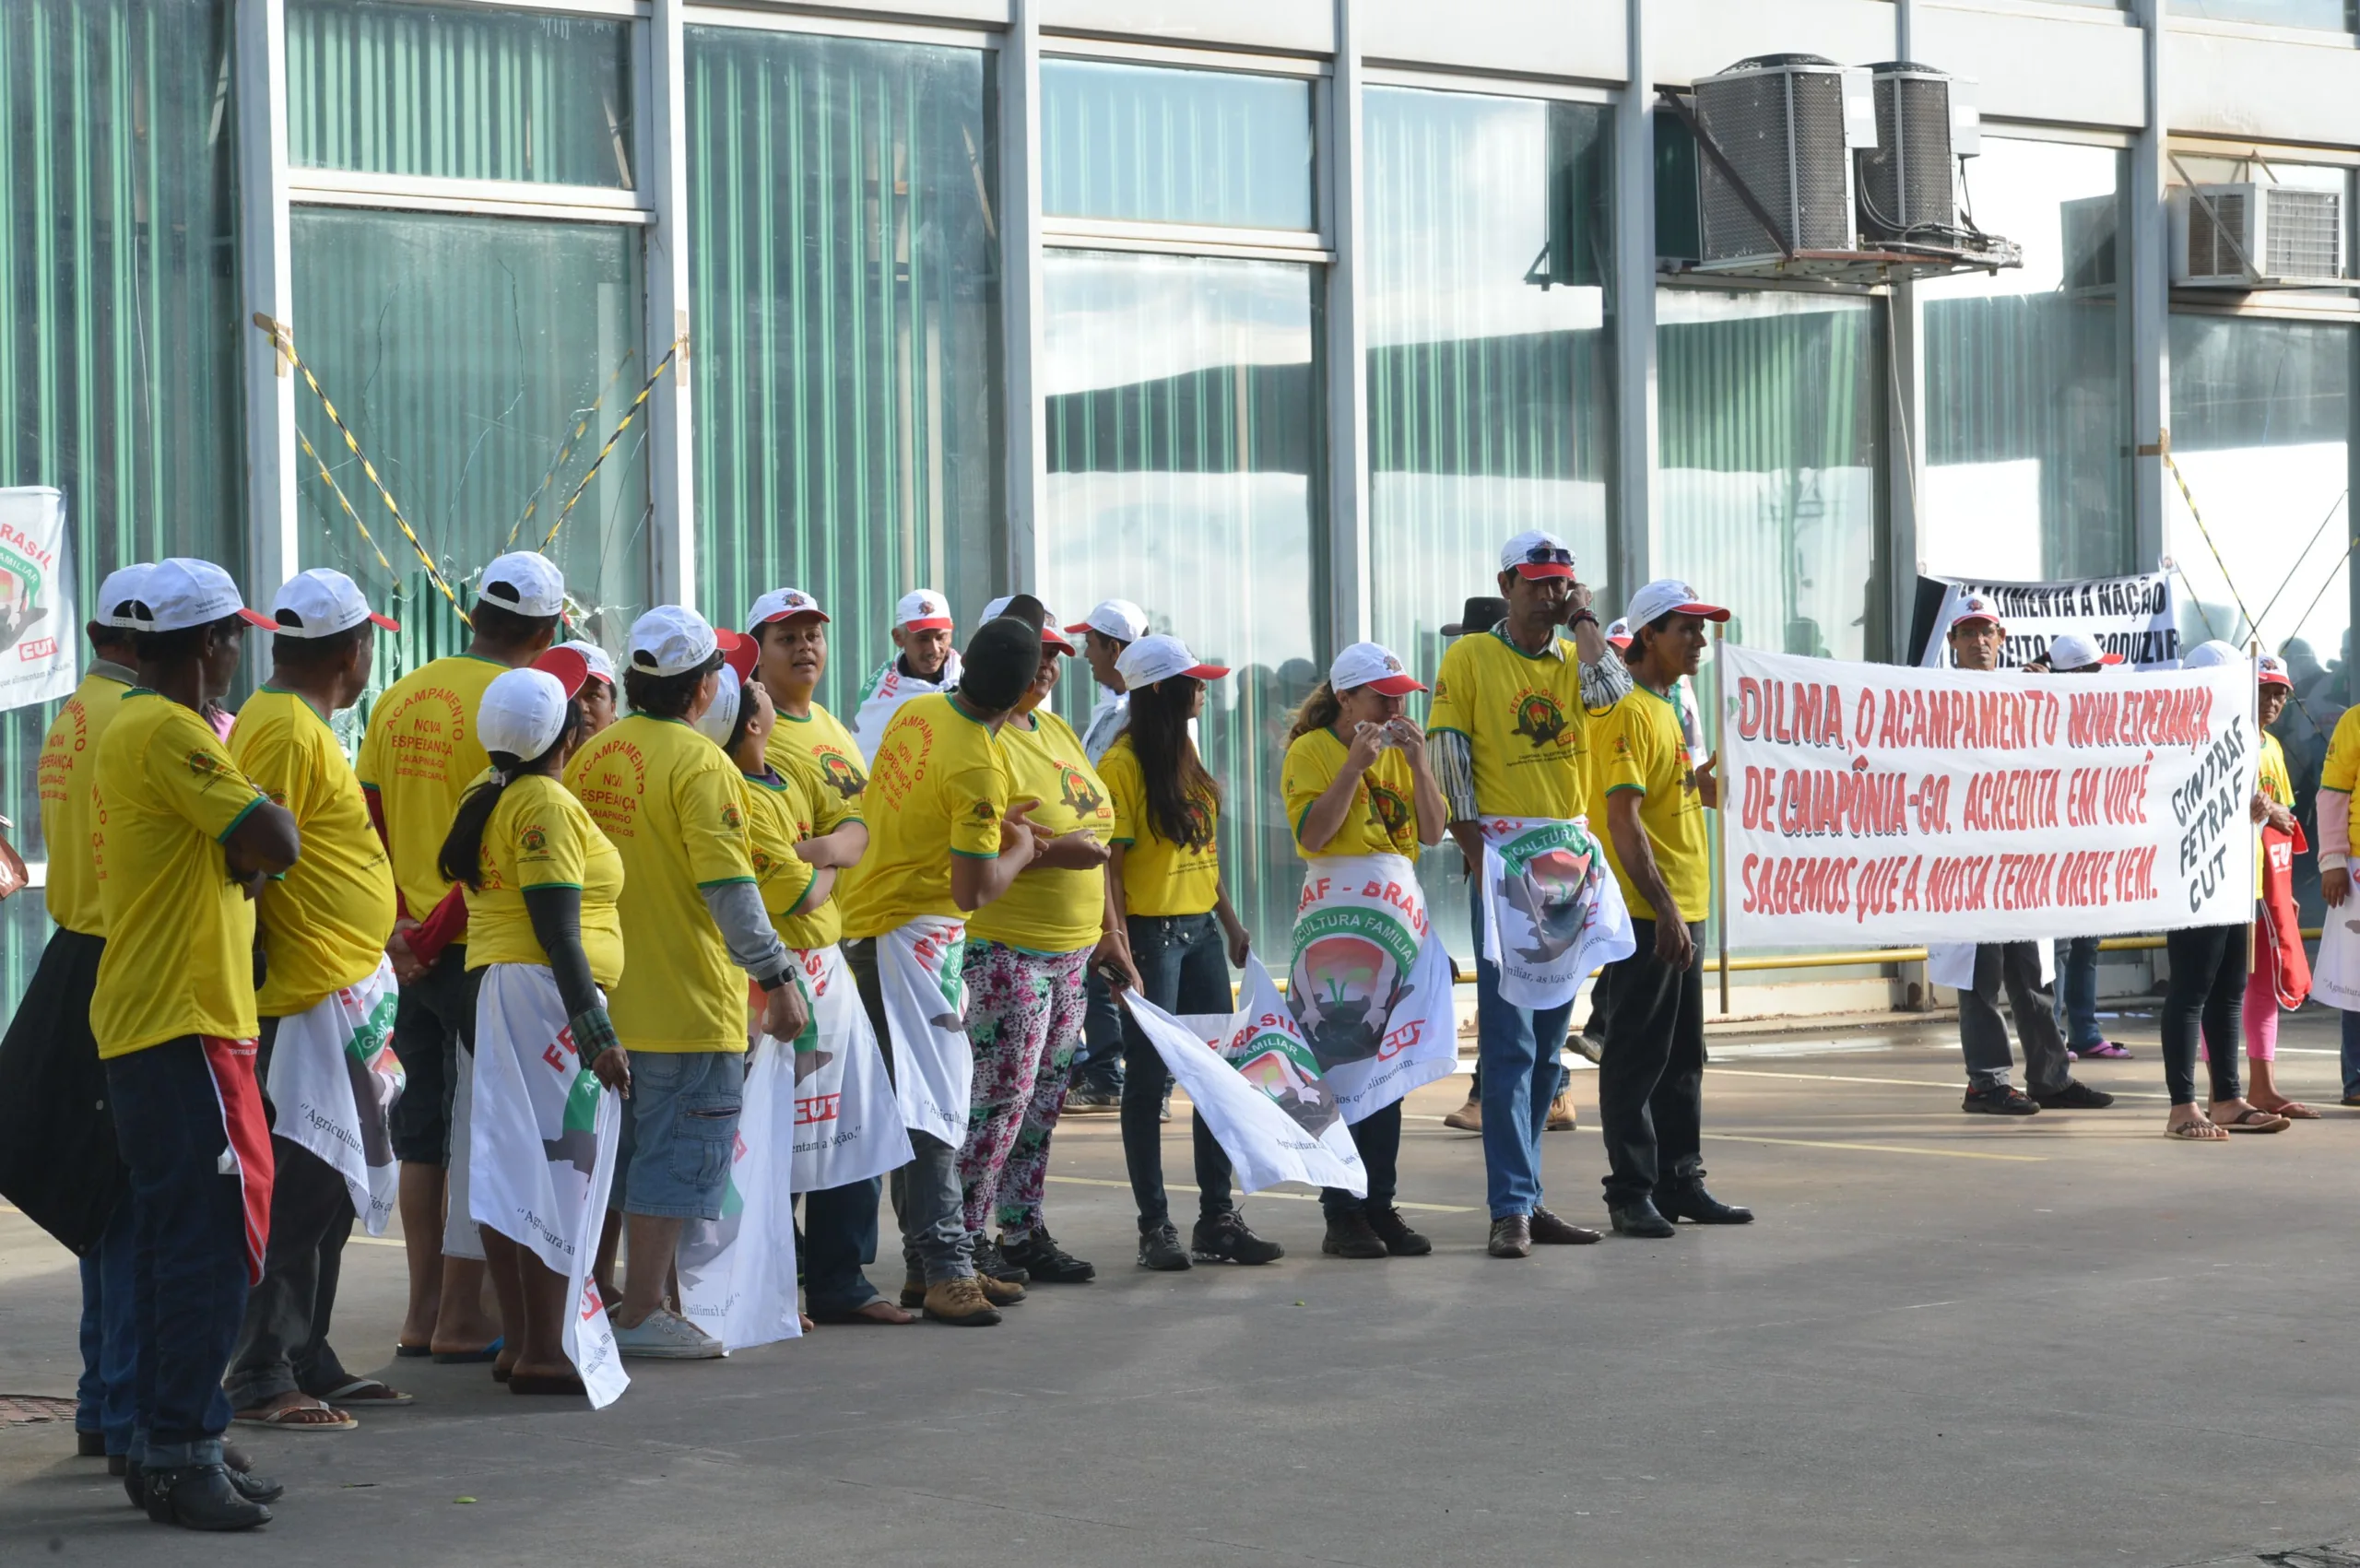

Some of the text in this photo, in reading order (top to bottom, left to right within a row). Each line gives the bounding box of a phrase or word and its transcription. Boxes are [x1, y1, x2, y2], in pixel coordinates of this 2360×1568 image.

[2081, 584, 2094, 617] A
[2097, 575, 2166, 622] NAÇÃO
[19, 637, 57, 661] CUT
[386, 688, 465, 741] ACAMPAMENTO
[1738, 677, 2212, 756] DILMA, O ACAMPAMENTO NOVA ESPERANÇA
[578, 740, 644, 795] ACAMPAMENTO
[1742, 749, 2154, 838] DE CAIAPÔNIA-GO. ACREDITA EM VOCÊ
[2180, 766, 2243, 878] FETRAF
[1742, 843, 2159, 924] SABEMOS QUE A NOSSA TERRA BREVE VEM.
[2189, 843, 2226, 914] CUT
[1242, 1037, 1298, 1058] AMILIAR
[1367, 1059, 1414, 1091] alimentam
